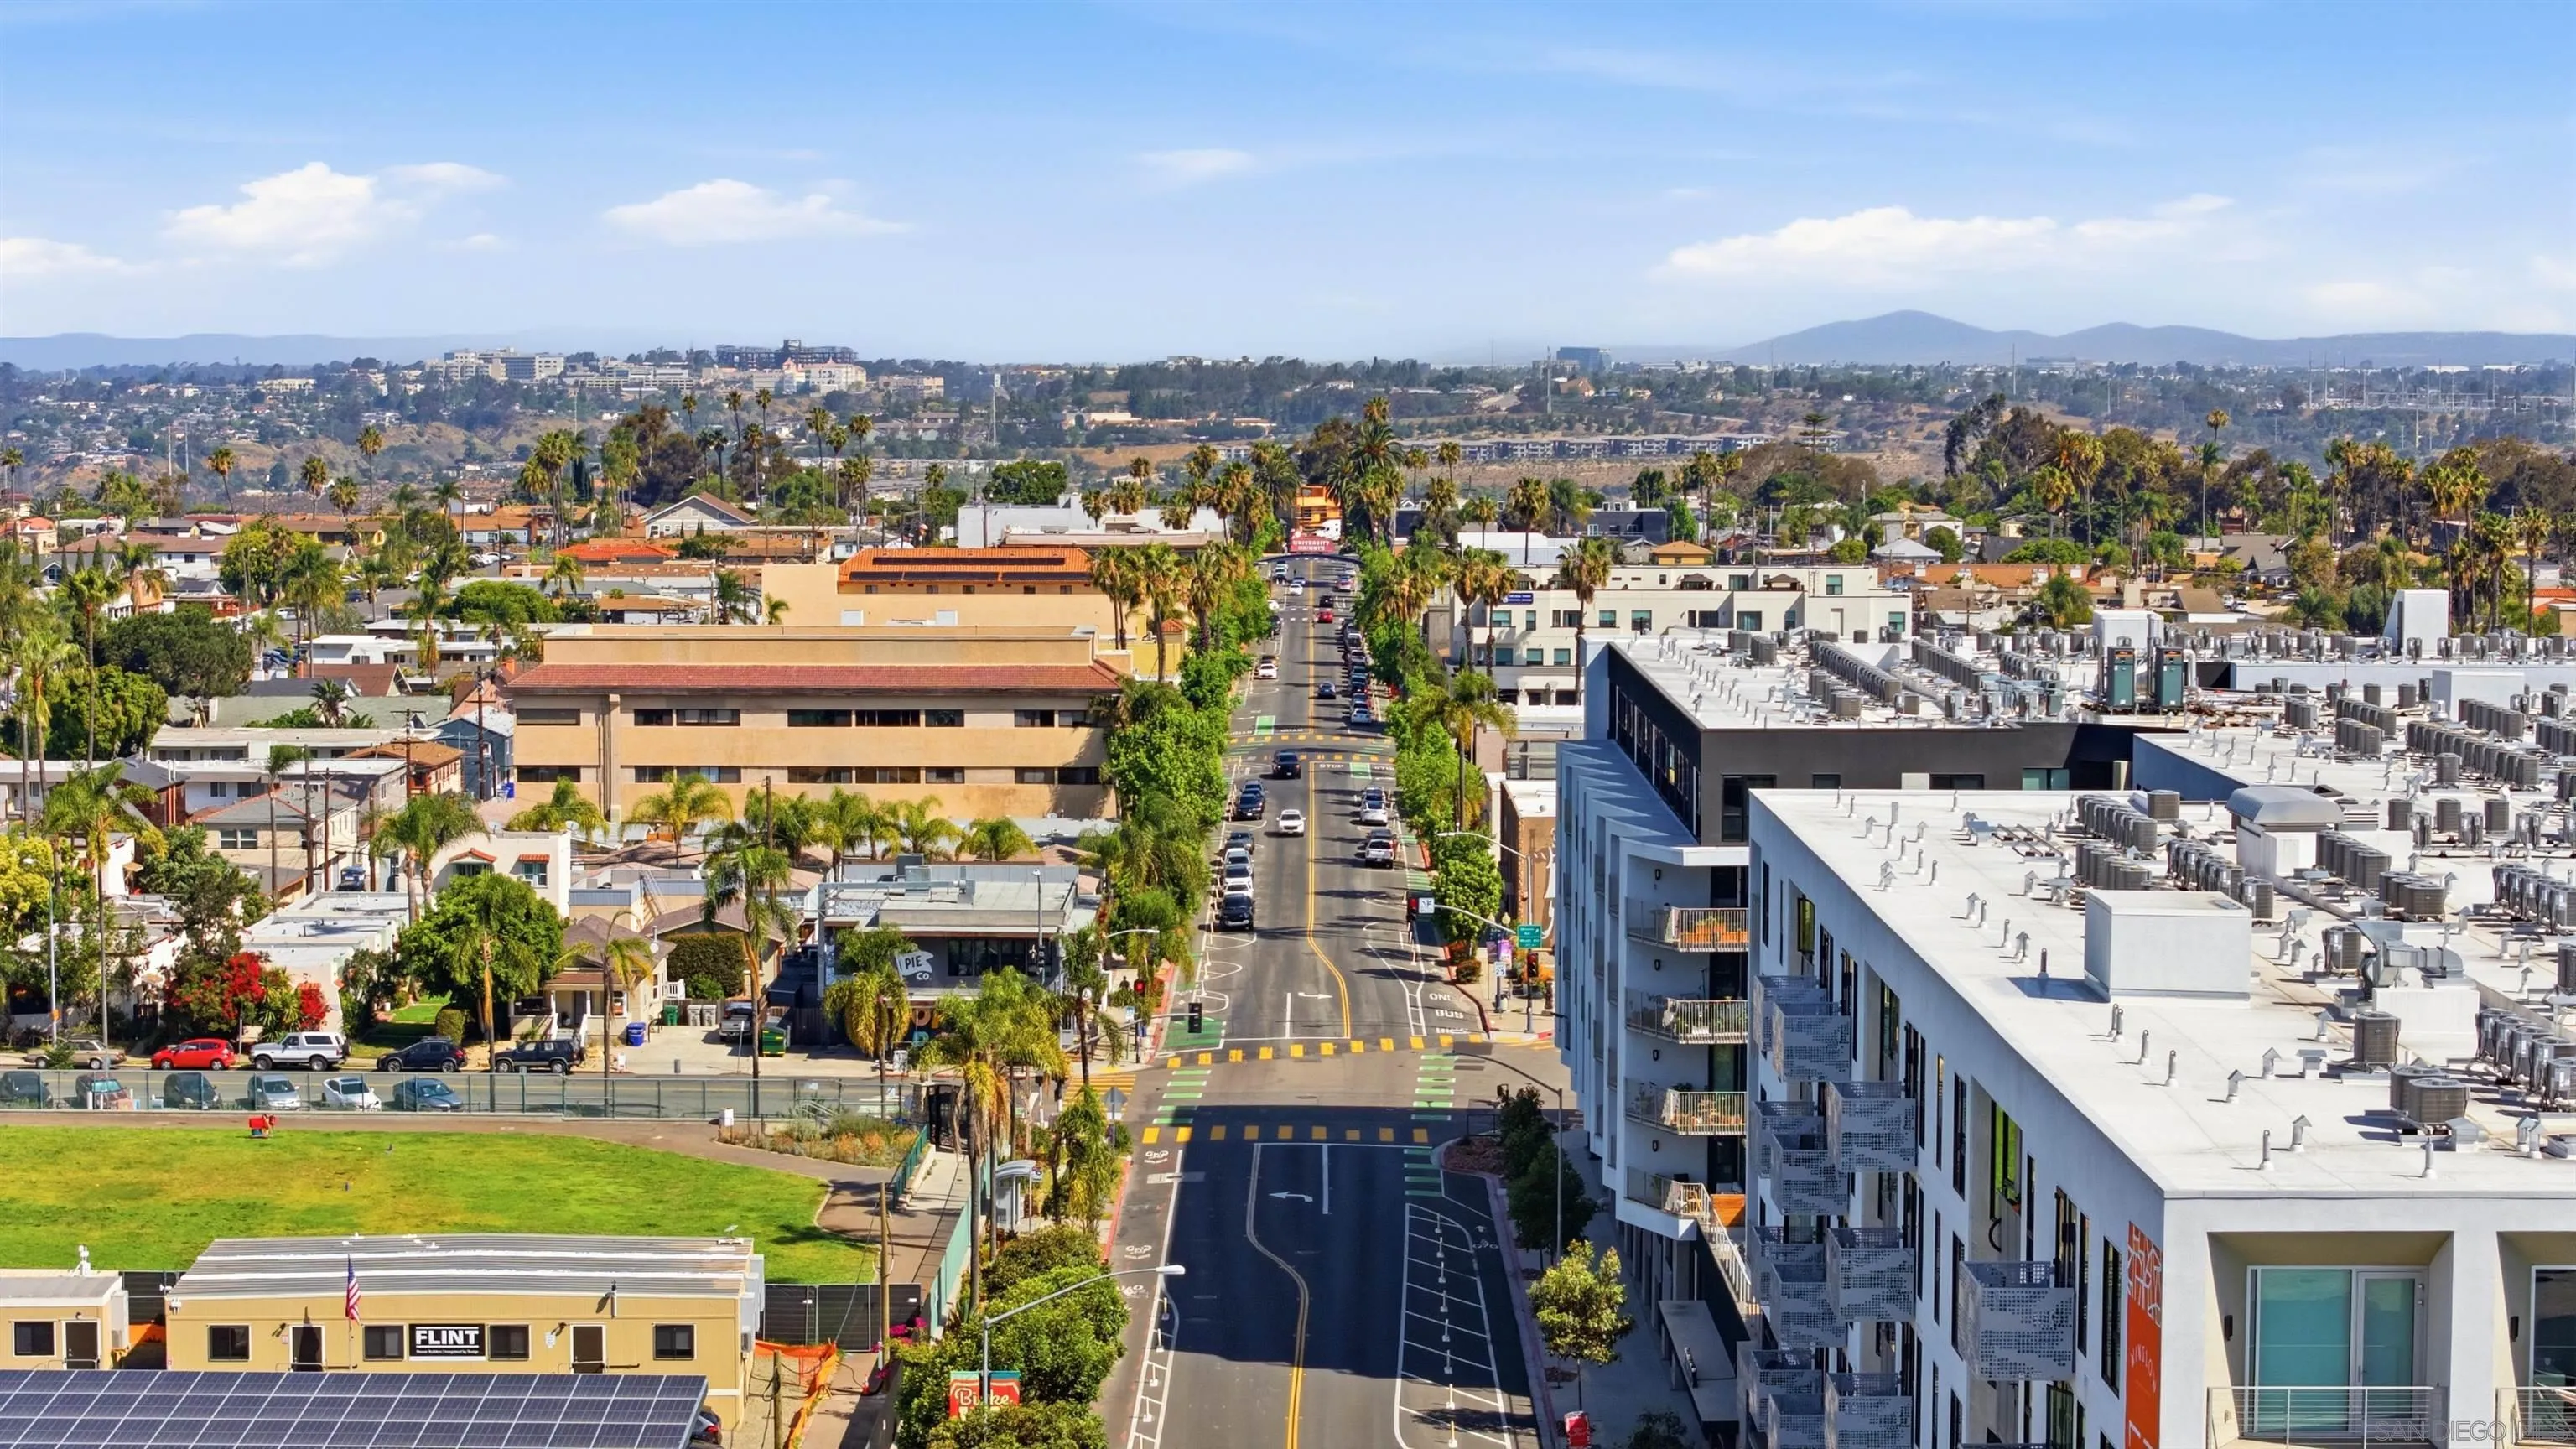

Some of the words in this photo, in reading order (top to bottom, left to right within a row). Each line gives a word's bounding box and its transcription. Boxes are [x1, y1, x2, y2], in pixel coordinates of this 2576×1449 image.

[905, 955, 922, 969] PIE
[1435, 1009, 1464, 1019] BUS
[416, 1330, 479, 1345] FLINT
